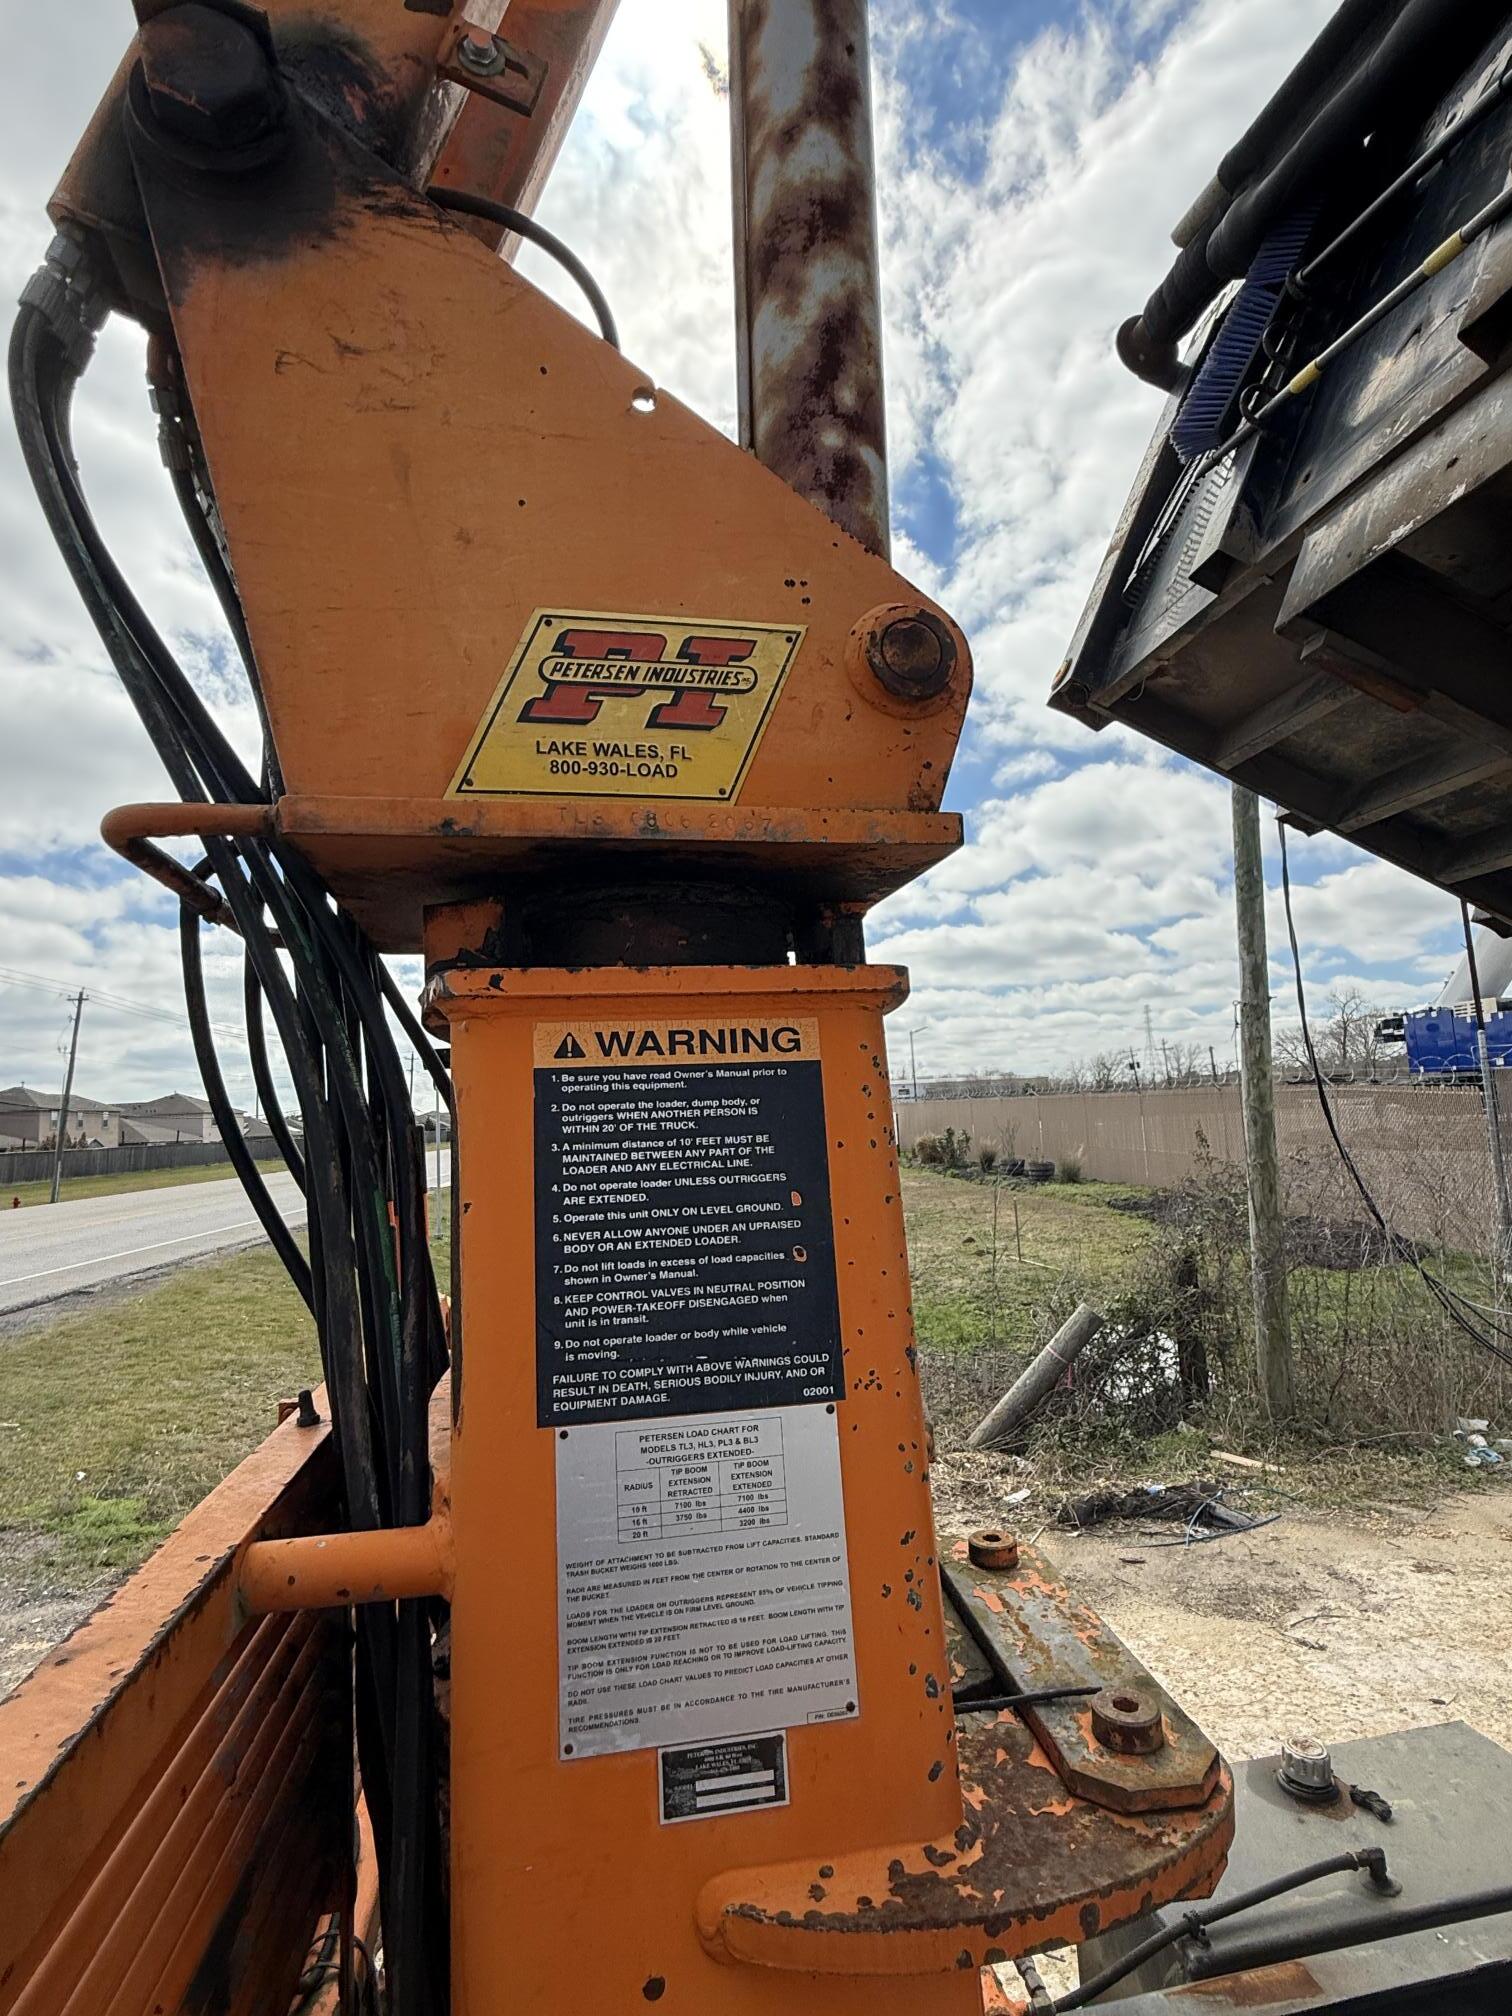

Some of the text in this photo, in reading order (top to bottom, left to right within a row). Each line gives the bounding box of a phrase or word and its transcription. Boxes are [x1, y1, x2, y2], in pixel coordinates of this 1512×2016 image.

[549, 661, 643, 682] PETERSEN
[642, 666, 745, 686] INDUSTRIES
[536, 740, 692, 761] LAKE WALES, FL
[550, 760, 678, 778] 800-930-LOAD
[594, 1028, 801, 1056] WARNING
[552, 1074, 559, 1082] 1.
[561, 1074, 574, 1082] Be
[602, 1074, 620, 1083] you
[623, 1072, 646, 1080] have
[649, 1071, 671, 1079] read
[673, 1070, 713, 1078] Owner's
[716, 1068, 749, 1077] Manual
[752, 1068, 774, 1078] prior
[561, 1081, 687, 1093] operating this equipment.
[551, 1104, 559, 1112] 2.
[562, 1103, 576, 1112] Do
[578, 1103, 594, 1111] not
[597, 1102, 635, 1112] operate
[638, 1101, 653, 1109] the
[656, 1100, 688, 1110] loader,
[691, 1099, 719, 1109] dump
[562, 1107, 758, 1124] outriggers WHEN ANOTHER PERSON IS
[562, 1124, 599, 1133] WITHIN
[619, 1123, 633, 1131] OF
[636, 1122, 656, 1131] THE
[660, 1121, 698, 1130] TRUCK.
[551, 1143, 560, 1151] 3.
[562, 1143, 569, 1151] A
[572, 1141, 619, 1151] minimum
[621, 1139, 664, 1149] distance
[666, 1138, 676, 1147] of
[695, 1137, 720, 1146] FEET
[724, 1135, 752, 1145] MUST
[755, 1135, 769, 1143] BE
[562, 1146, 775, 1163] MAINTAINED BETWEEN ANY PART OF THE
[563, 1159, 752, 1175] LOADER AND ANY ELECTRICAL LINE.
[552, 1173, 787, 1192] 4. Do not operate loader UNLESS OUTRIGGERS
[563, 1193, 649, 1205] ARE EXTENDED.
[553, 1203, 784, 1224] 5. Operate this unit ONLY ON LEVEL GROUND.
[565, 1315, 649, 1328] unit is in transit.
[553, 1354, 829, 1385] FAILURE TO COMPLY WITH ABOVE WARNINGS COULD
[553, 1386, 594, 1398] RESULT
[598, 1385, 608, 1394] IN
[612, 1381, 650, 1395] DEATH,
[653, 1377, 701, 1390] SERIOUS
[703, 1374, 740, 1385] BODILY
[785, 1368, 807, 1378] AND
[809, 1367, 825, 1376] OR
[803, 1386, 834, 1397] 02001
[553, 1398, 616, 1412] EQUIPMENT
[639, 1424, 759, 1443] PETERSEN LOAD CHART FOR
[641, 1444, 676, 1454] MODELS
[717, 1439, 732, 1447] PL3
[735, 1438, 741, 1446] &
[743, 1436, 759, 1445] BL3
[671, 1466, 708, 1476] TIP BOOM
[733, 1459, 769, 1469] TIP BOOM
[669, 1476, 711, 1486] EXTENSION
[731, 1470, 772, 1480] EXTENSION
[624, 1482, 653, 1492] RADIUS
[668, 1487, 712, 1498] RETRACTED
[733, 1480, 772, 1491] EXTENDED
[641, 1505, 647, 1513] ft
[642, 1530, 648, 1538] ft
